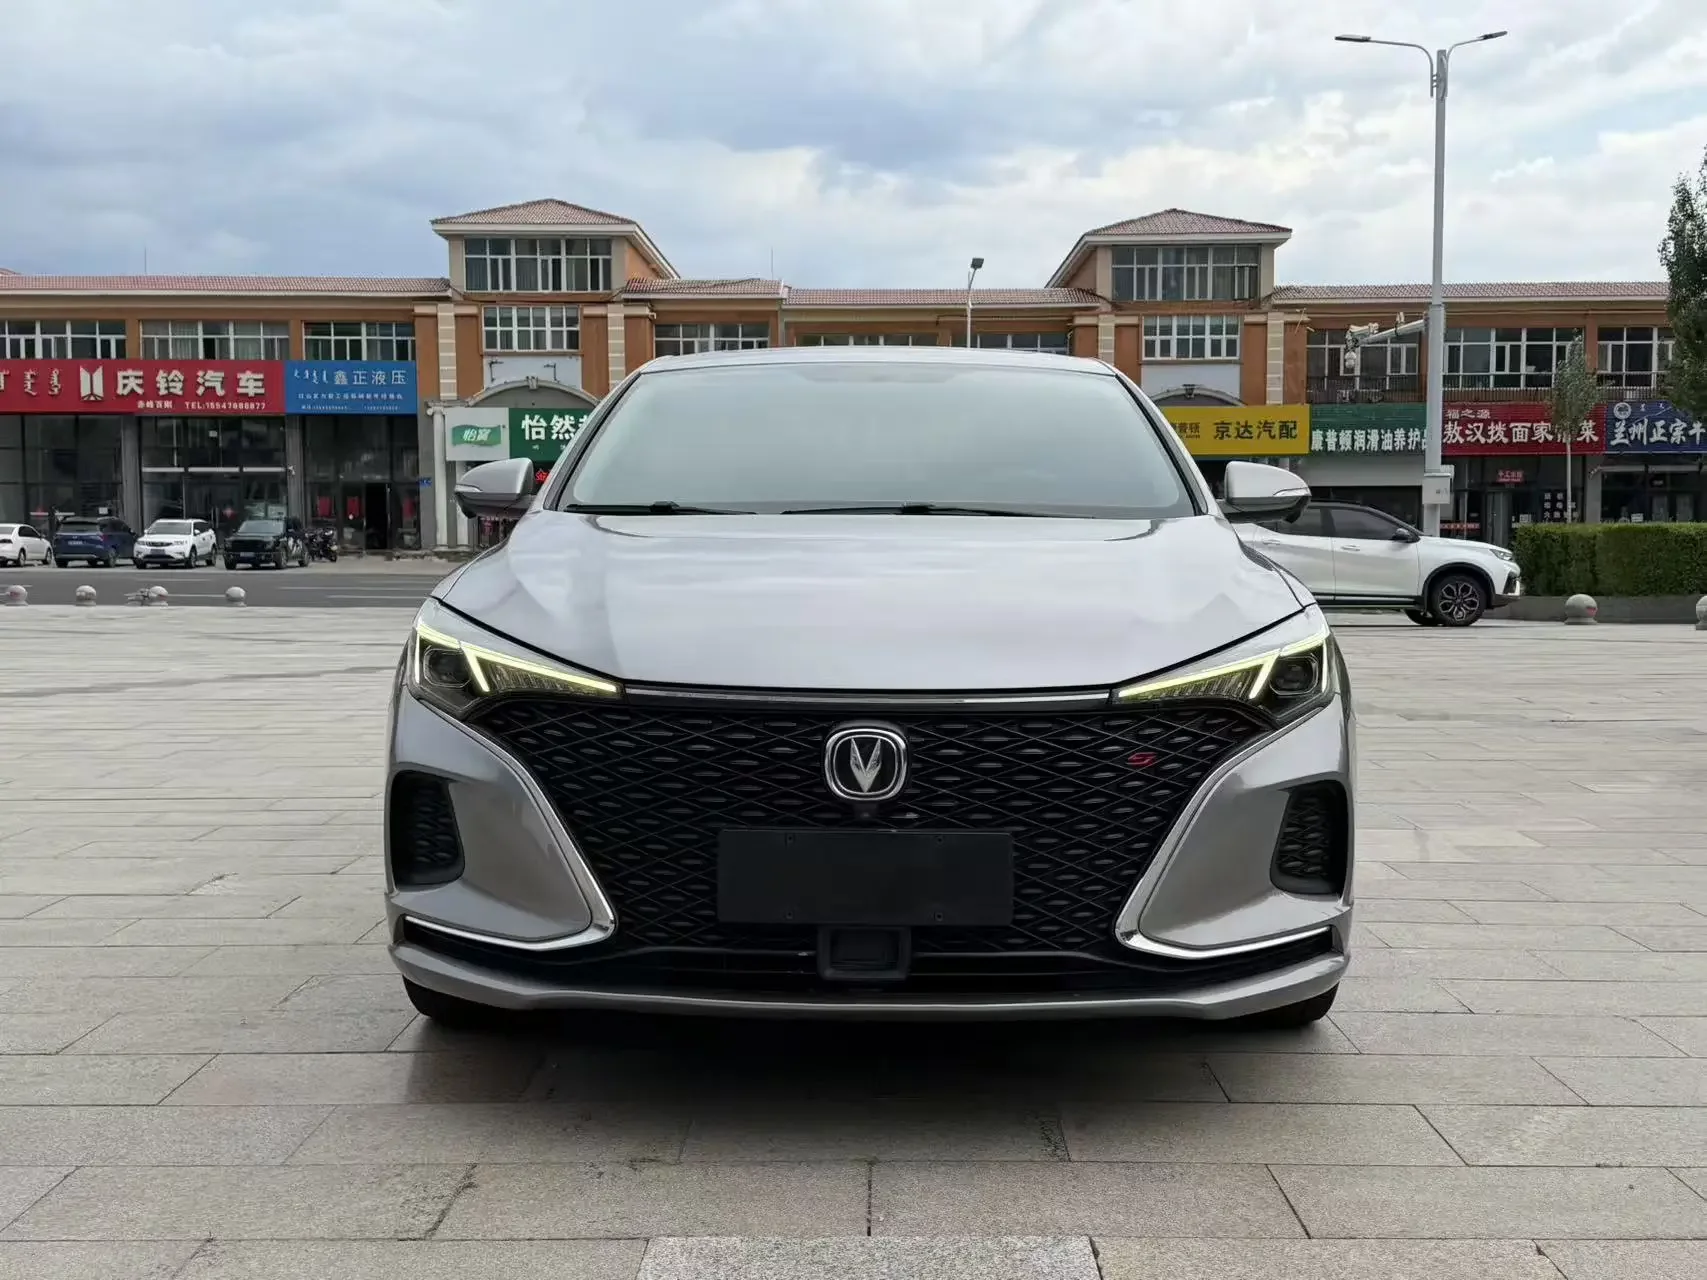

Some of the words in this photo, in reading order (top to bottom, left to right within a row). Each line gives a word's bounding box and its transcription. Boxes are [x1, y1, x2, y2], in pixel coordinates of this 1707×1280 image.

[116, 368, 265, 397] 庆铃汽车
[333, 369, 407, 385] 鑫正液压
[521, 414, 588, 441] 怡然
[1213, 420, 1298, 440] 京达汽配
[1610, 417, 1706, 446] 兰州正宗牛
